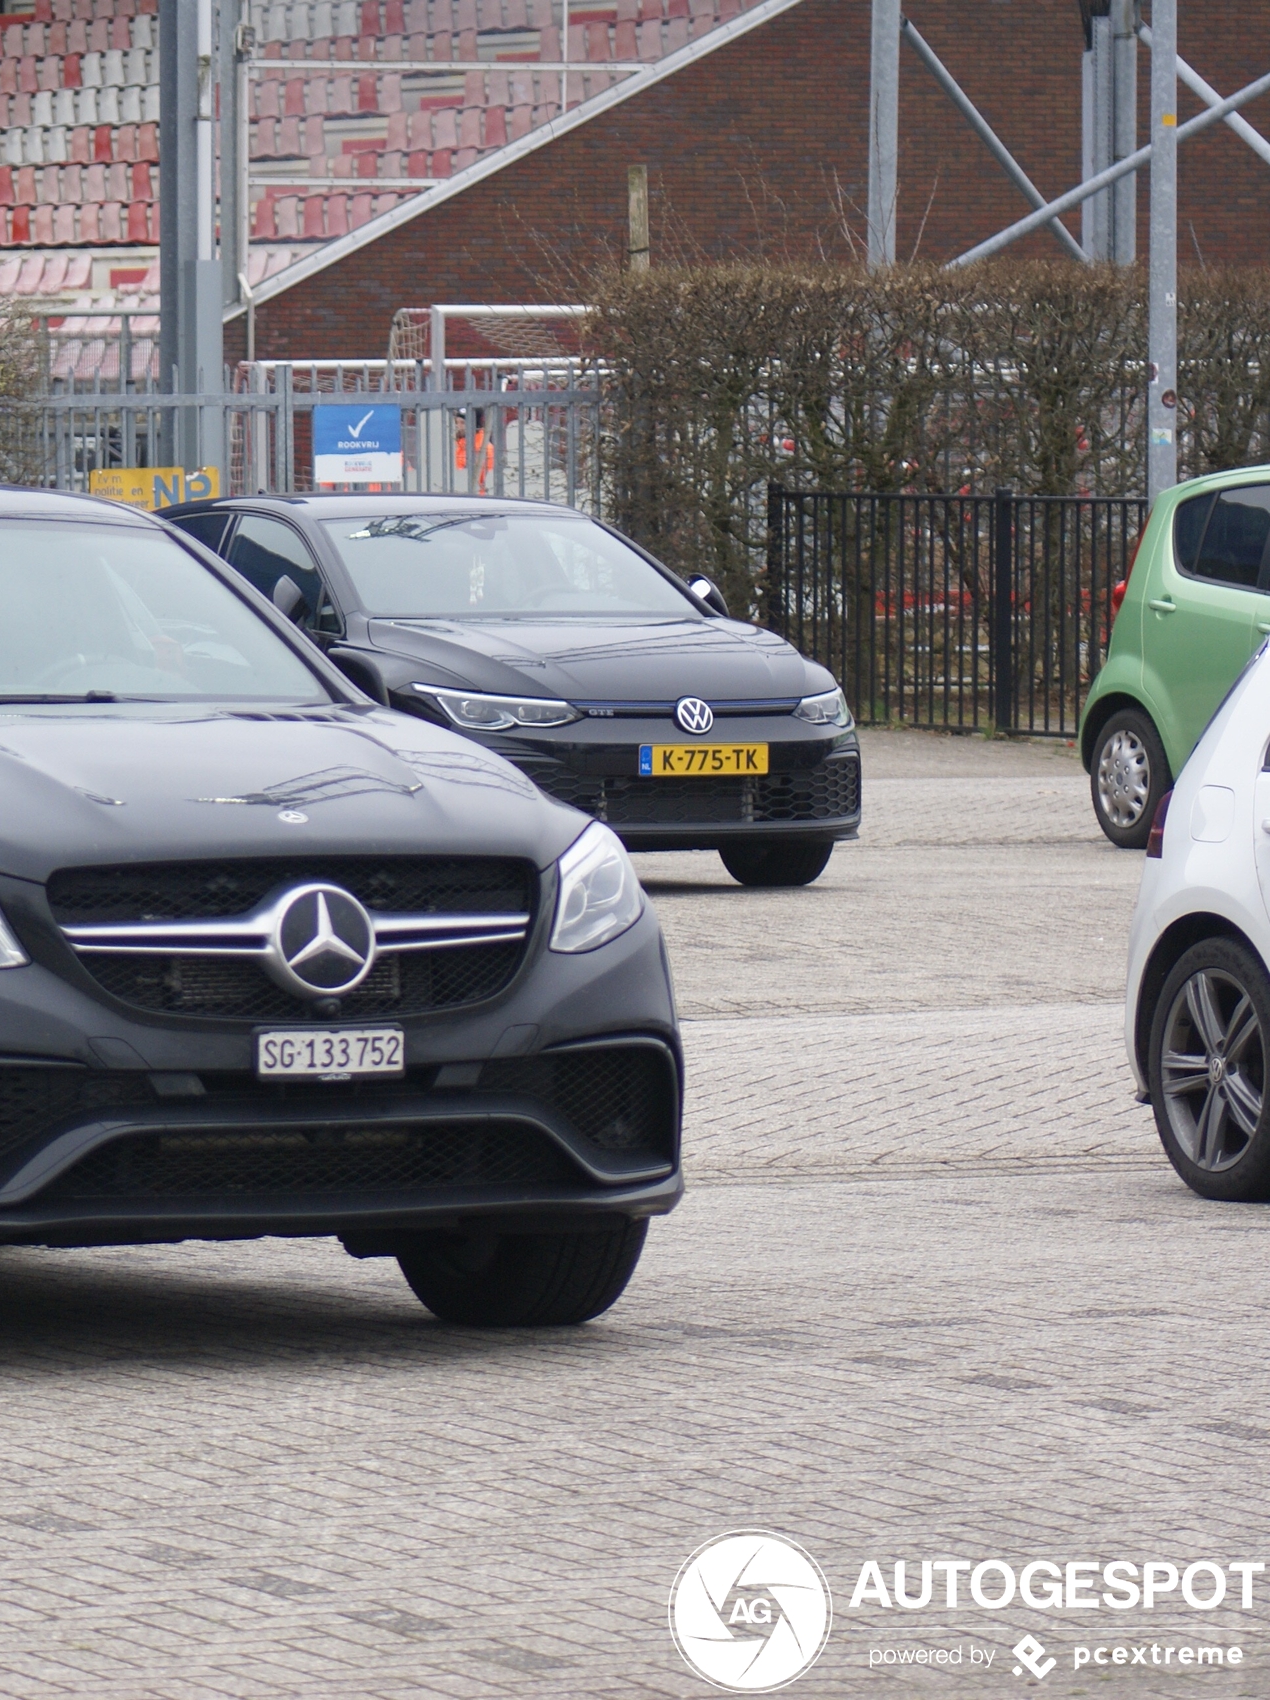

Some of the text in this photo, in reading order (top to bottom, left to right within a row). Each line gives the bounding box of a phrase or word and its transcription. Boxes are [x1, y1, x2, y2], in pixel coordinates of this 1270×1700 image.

[338, 441, 379, 449] ROOKVRIJ
[94, 486, 143, 497] politie en
[153, 474, 212, 508] NP
[641, 749, 758, 771] NL K-775-TK
